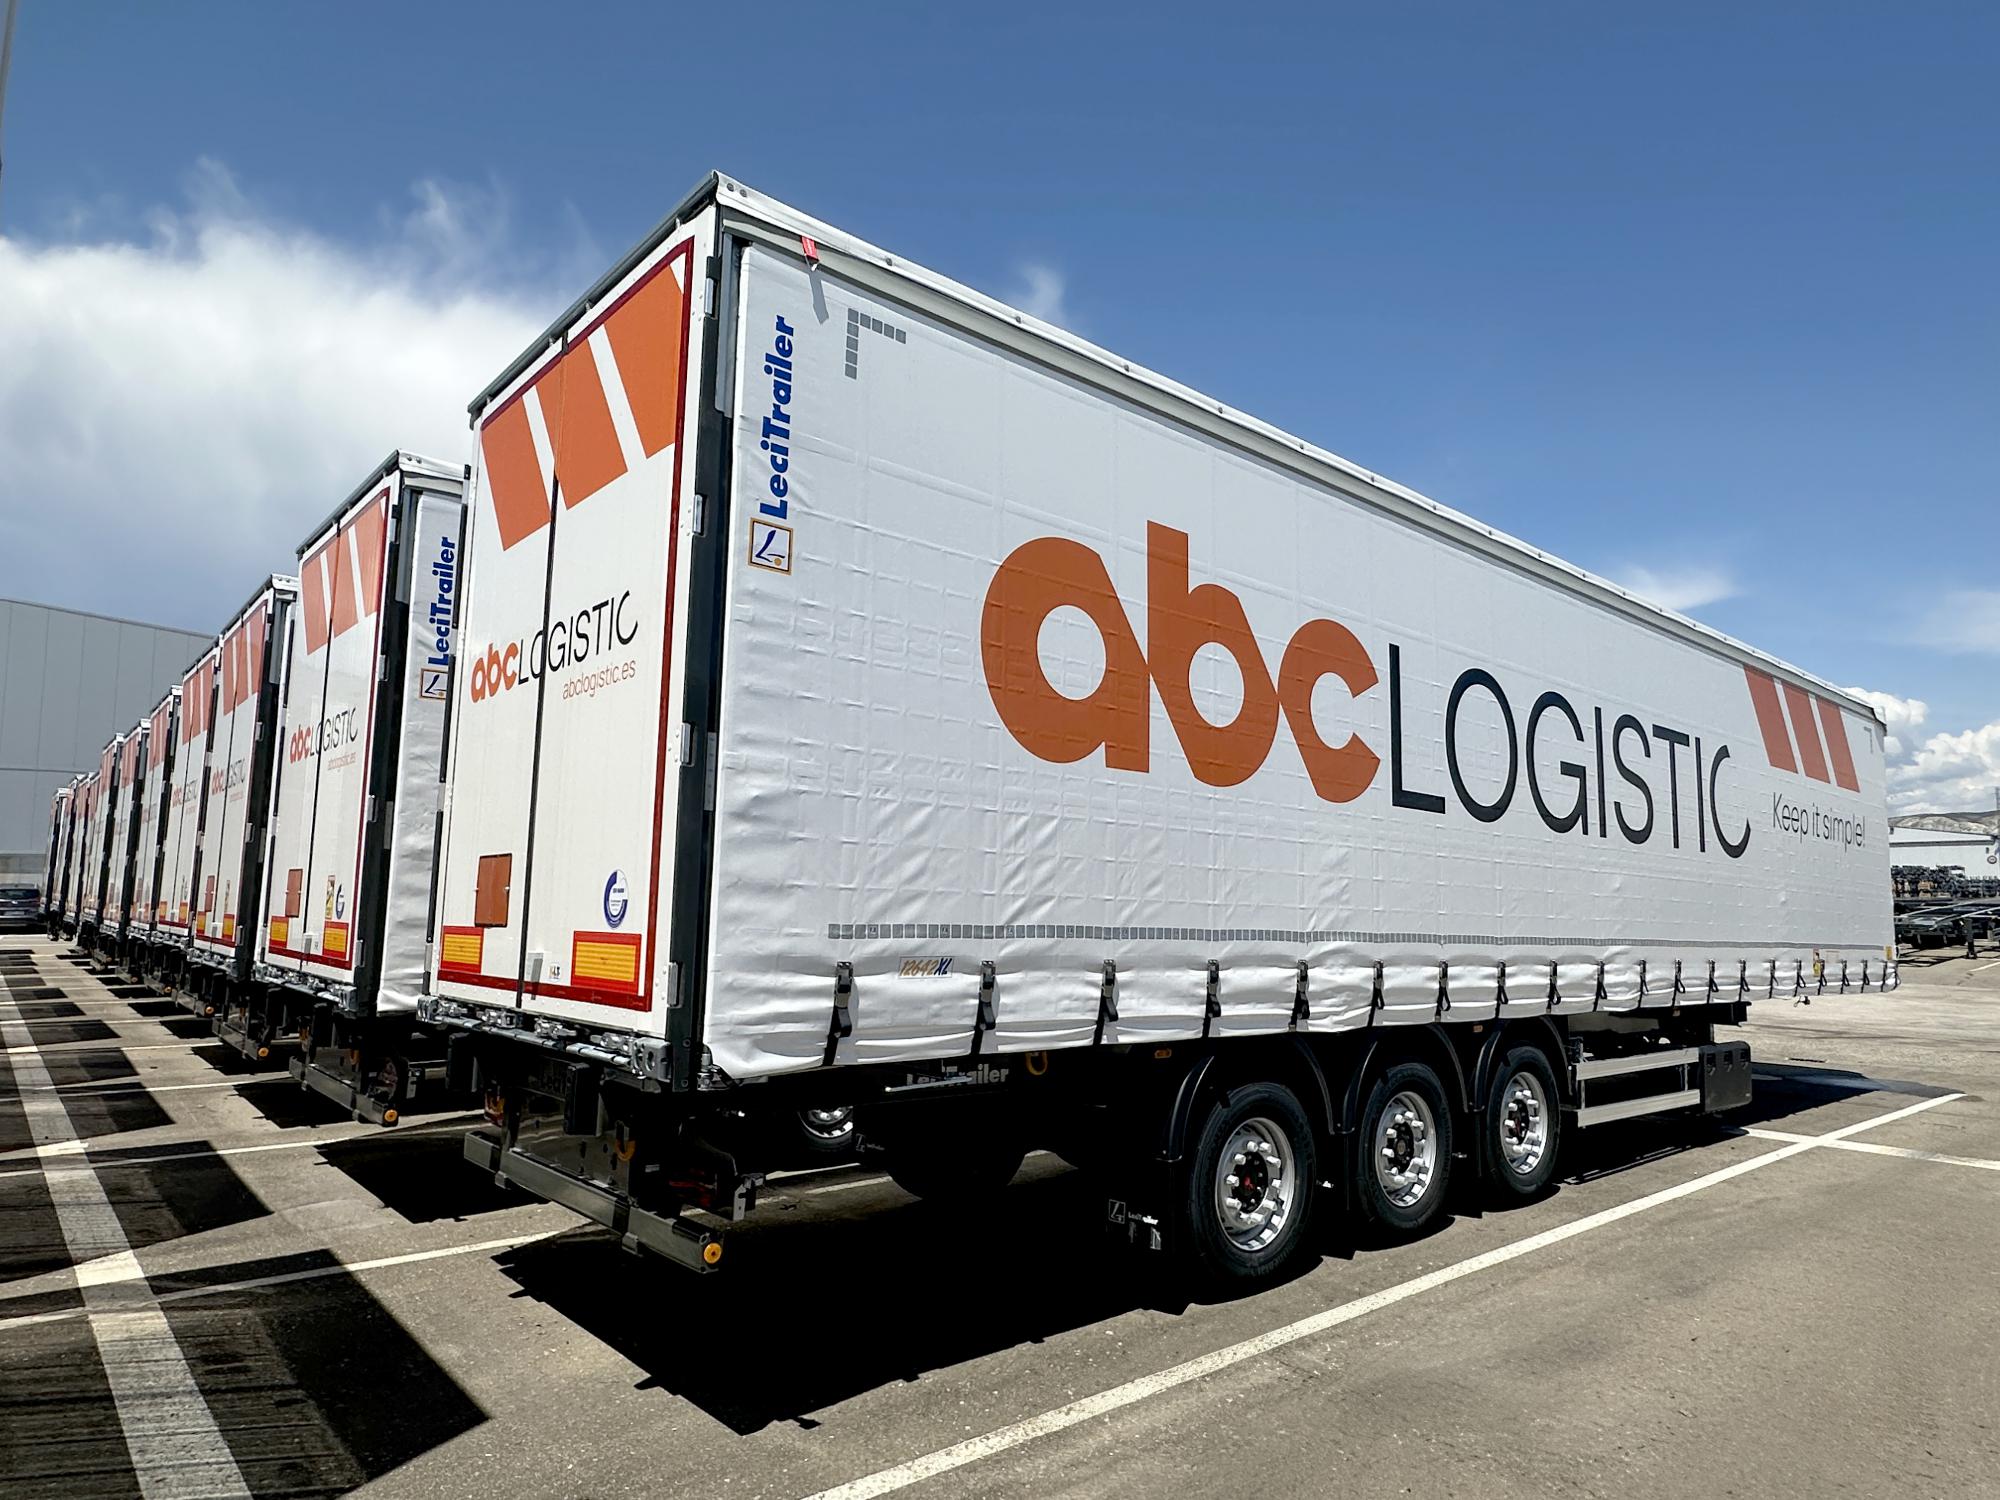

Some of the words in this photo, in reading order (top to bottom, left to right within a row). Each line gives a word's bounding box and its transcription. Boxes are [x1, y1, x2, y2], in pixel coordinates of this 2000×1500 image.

[759, 315, 794, 520] LeciTrailer
[428, 536, 456, 666] LeciTrailer
[562, 659, 637, 700] abclogistic.es
[1772, 791, 1809, 844] Keep
[1812, 802, 1821, 838] it
[1822, 807, 1866, 853] simple!
